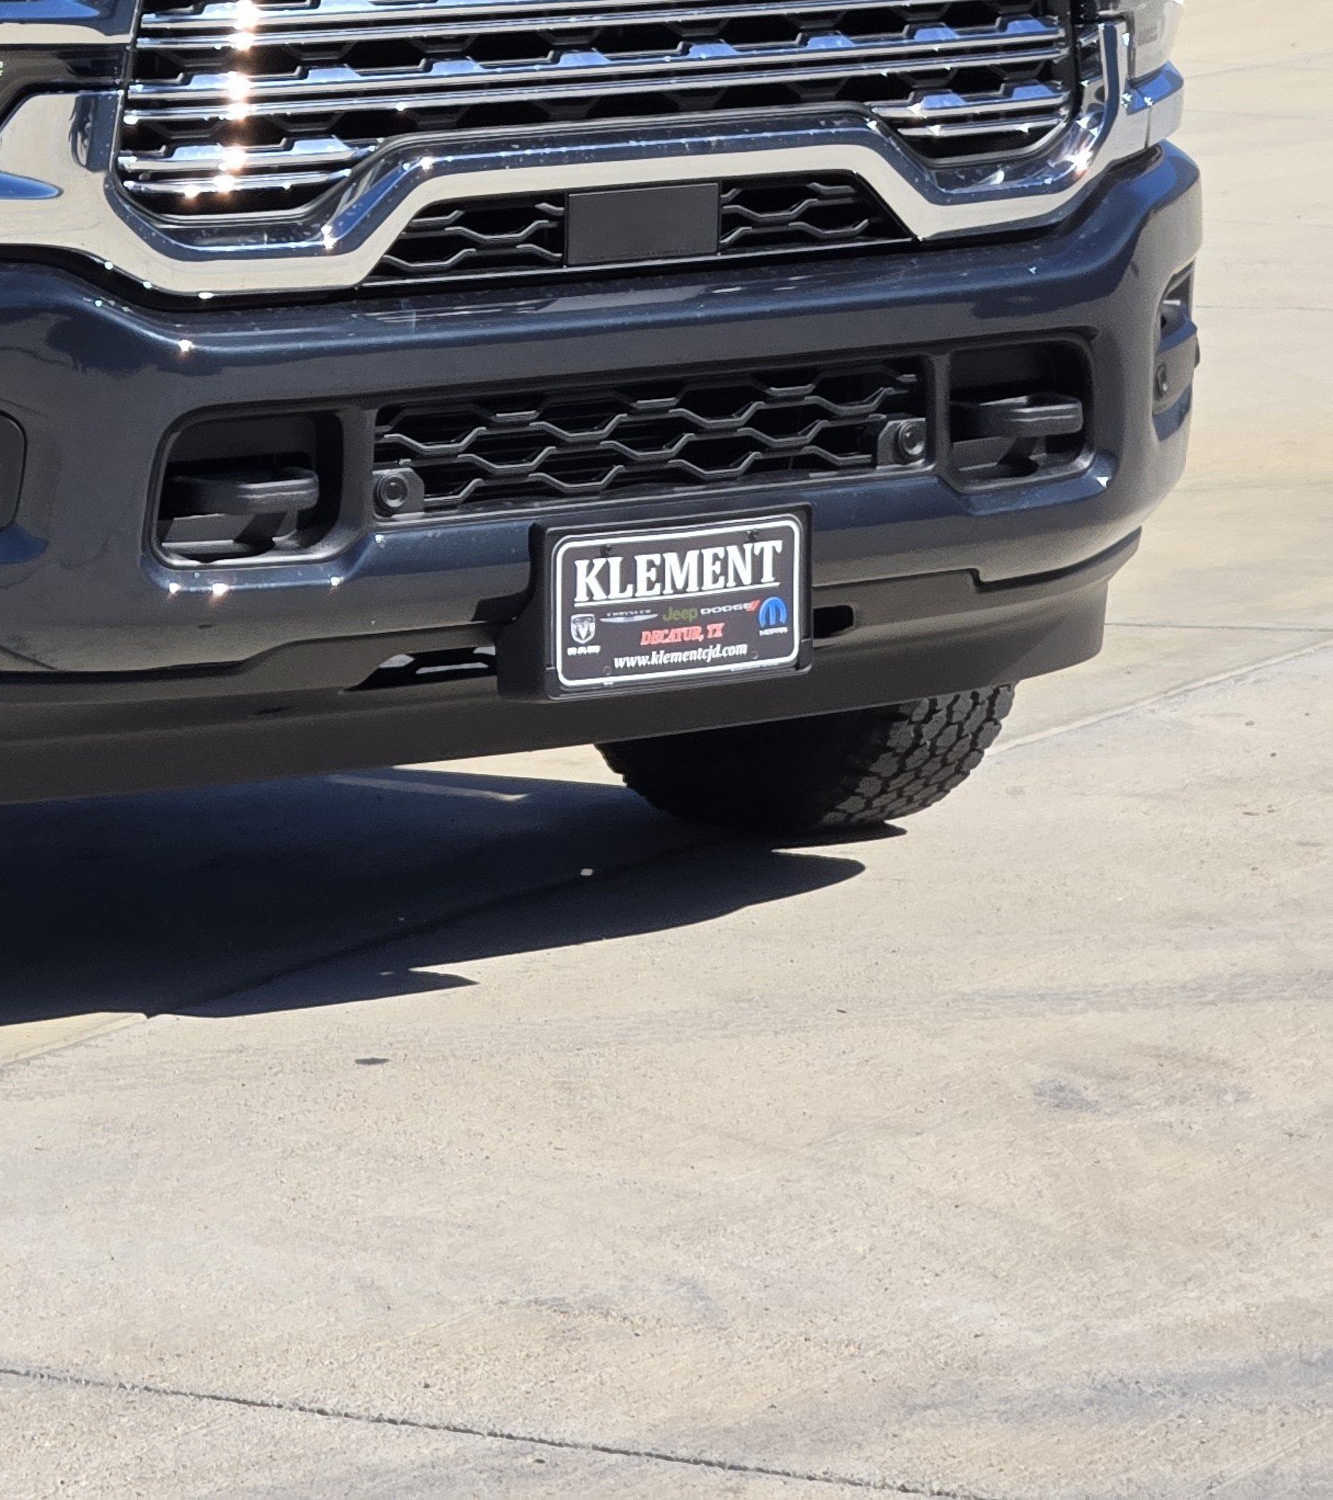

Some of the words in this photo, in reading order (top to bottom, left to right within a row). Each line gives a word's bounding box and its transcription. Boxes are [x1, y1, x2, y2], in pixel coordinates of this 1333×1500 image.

[574, 540, 783, 602] KLEMENT
[662, 606, 698, 622] Jeep
[614, 643, 748, 669] www.klementcjd.com
